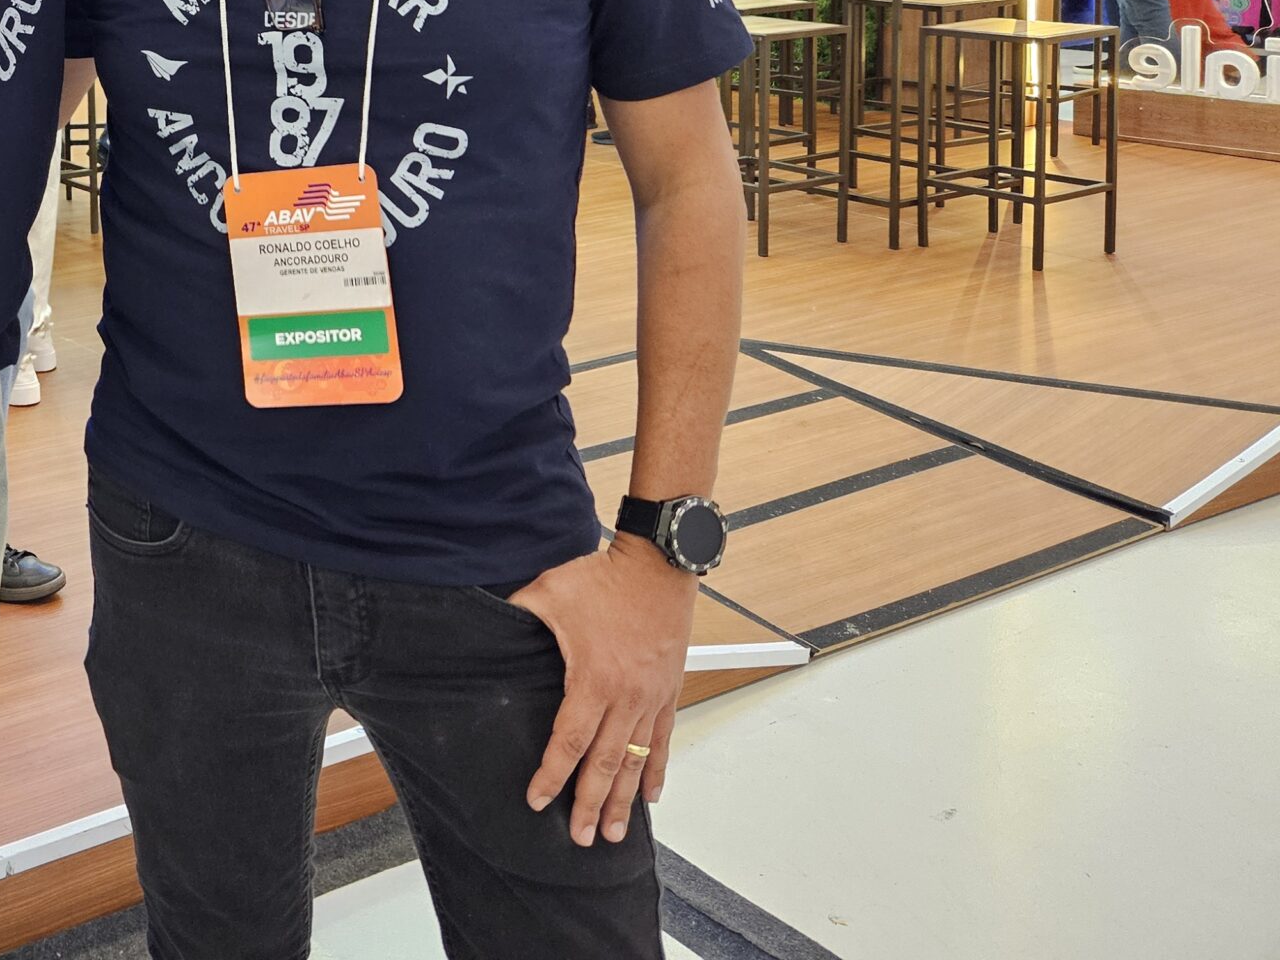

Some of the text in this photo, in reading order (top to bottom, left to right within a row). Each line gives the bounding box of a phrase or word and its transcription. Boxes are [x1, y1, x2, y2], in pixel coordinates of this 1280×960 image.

[257, 30, 327, 98] 19
[270, 95, 345, 168] 87
[264, 207, 315, 227] ABAV
[258, 237, 361, 255] RONALDO COELHO
[273, 253, 349, 267] ANCORADOURO
[279, 268, 308, 276] GERENTE
[320, 266, 345, 274] VENDAS
[274, 328, 362, 346] EXPOSITOR
